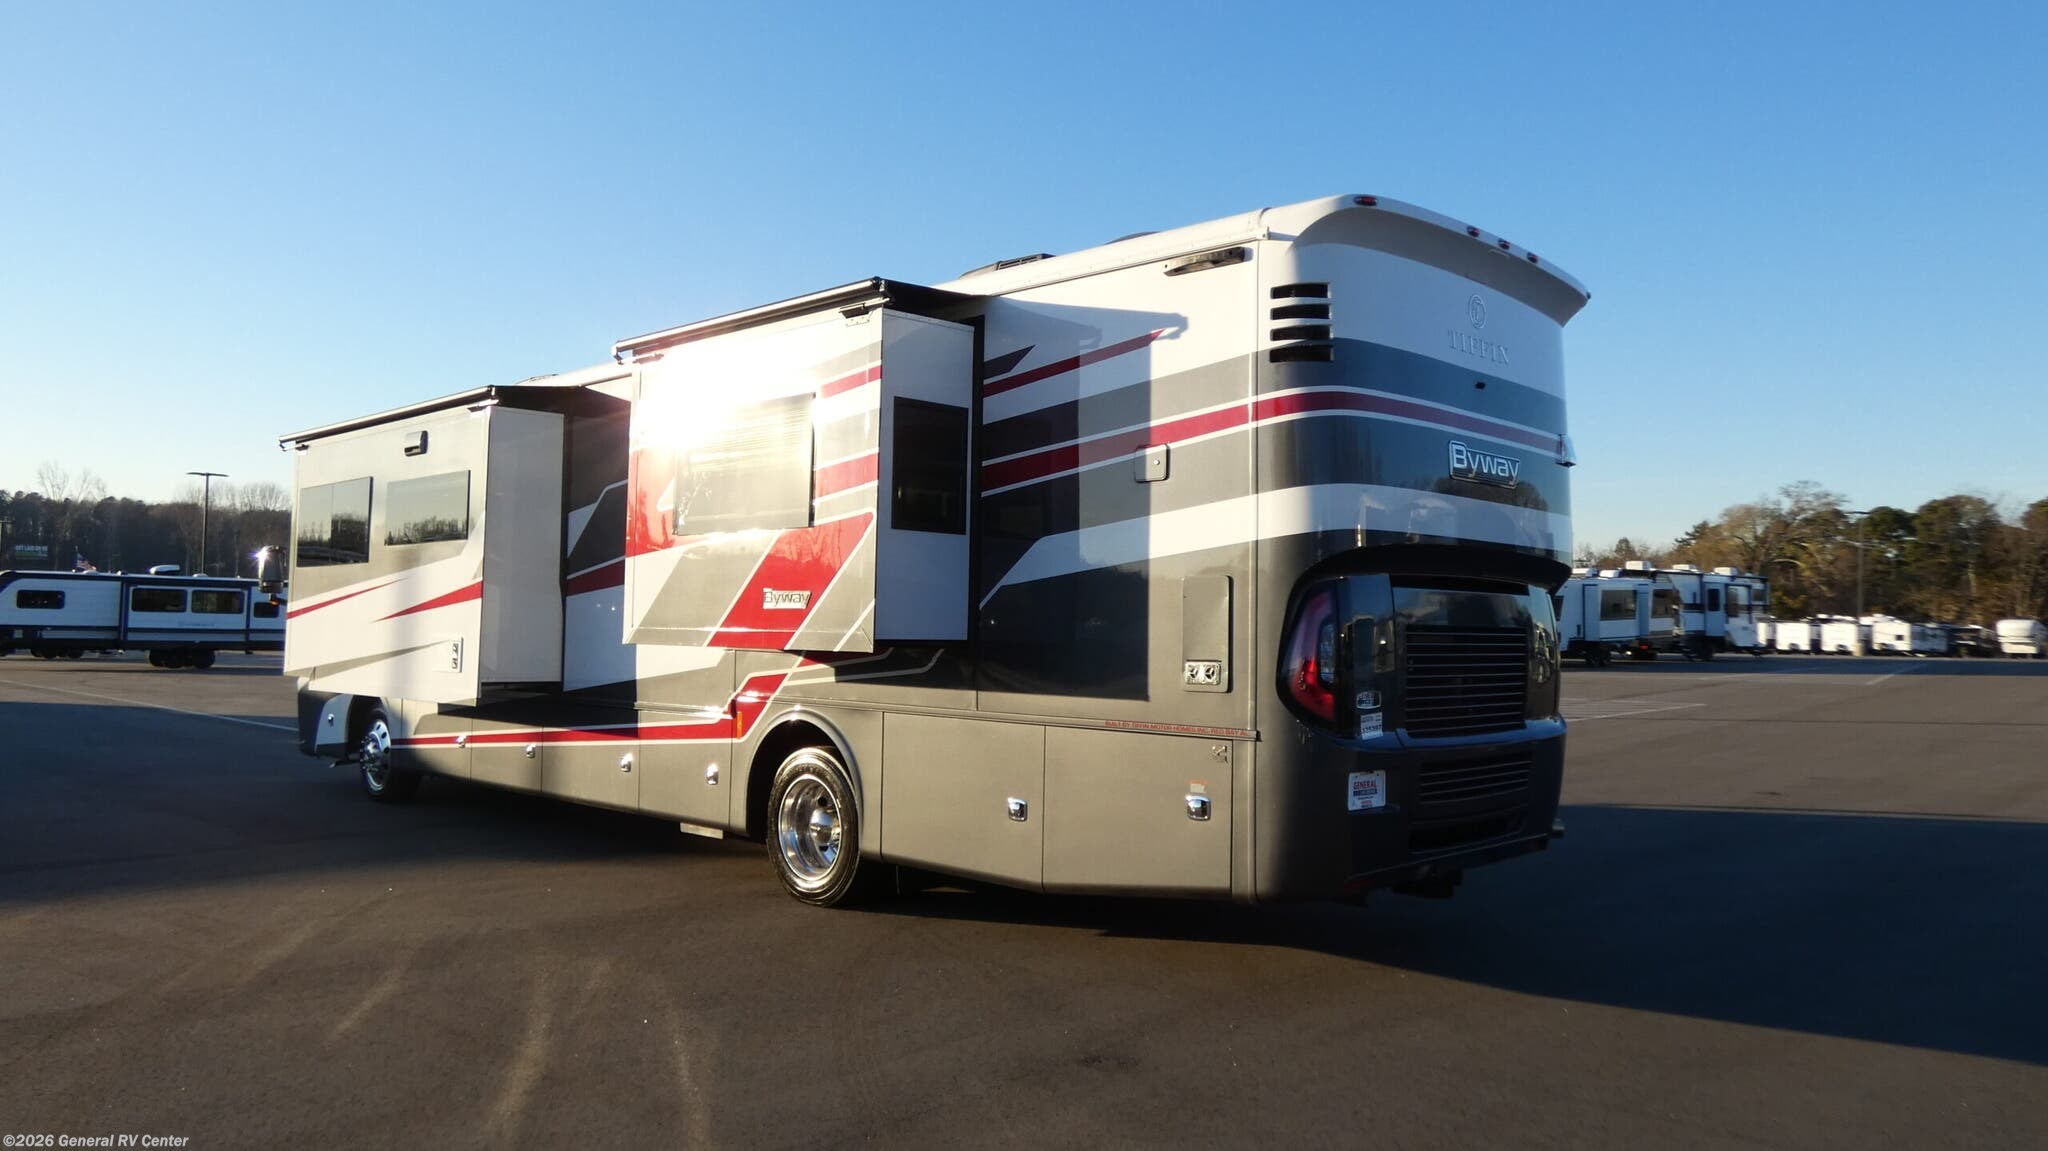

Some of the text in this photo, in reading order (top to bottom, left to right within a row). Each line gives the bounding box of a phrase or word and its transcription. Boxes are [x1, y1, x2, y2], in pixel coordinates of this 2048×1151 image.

[1448, 329, 1509, 365] TIFFIN
[1451, 443, 1520, 485] Byway
[764, 591, 810, 607] Byway
[1353, 780, 1377, 790] GENERAL
